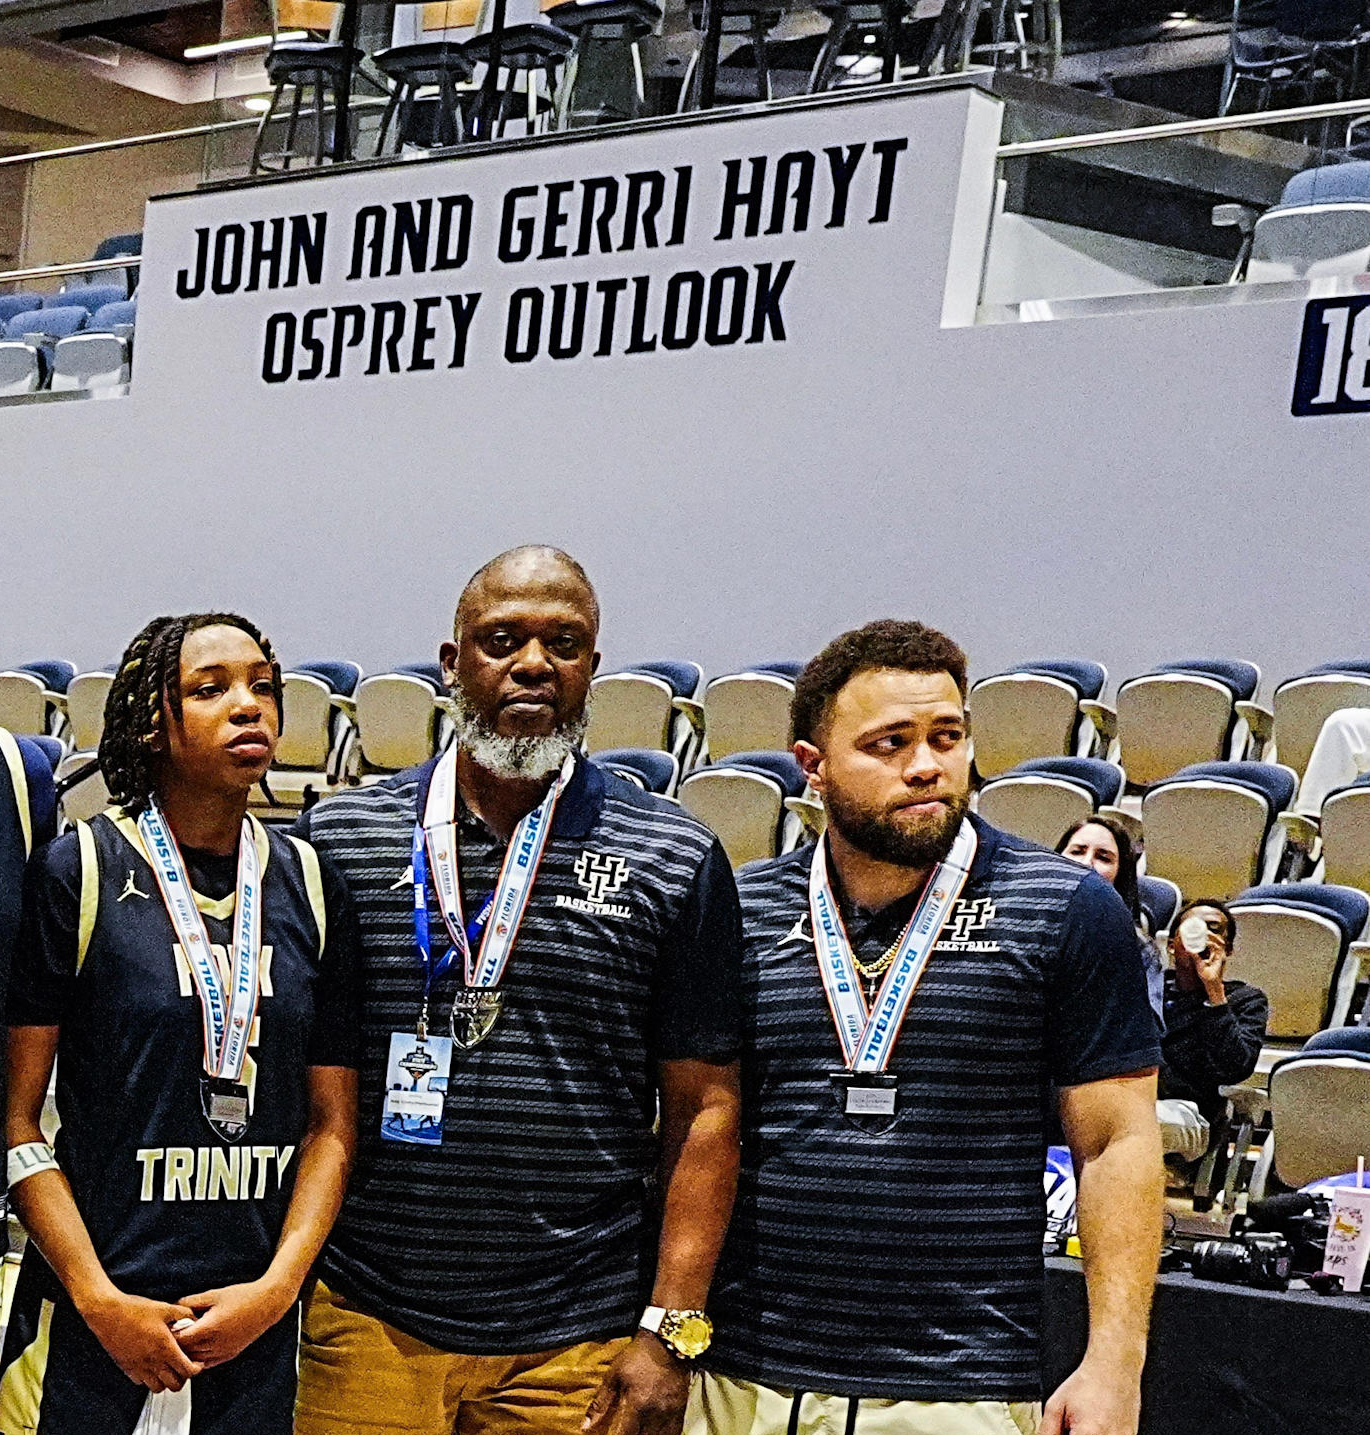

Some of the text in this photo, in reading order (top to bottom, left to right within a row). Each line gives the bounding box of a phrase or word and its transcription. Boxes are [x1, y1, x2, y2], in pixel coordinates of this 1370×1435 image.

[176, 137, 909, 300] JOHN AND GERRI HAYT
[262, 260, 796, 384] OSPREY OUTLOOK
[238, 883, 253, 994] BASKETBALL
[500, 887, 517, 922] FLORIDA
[555, 894, 632, 919] BASKETBALL
[817, 889, 850, 994] BASKETBALL
[919, 904, 941, 936] FLORIDA
[863, 948, 920, 1063] BASKETBALL
[226, 1029, 242, 1068] FLORIDA
[136, 1145, 296, 1202] TRINITY
